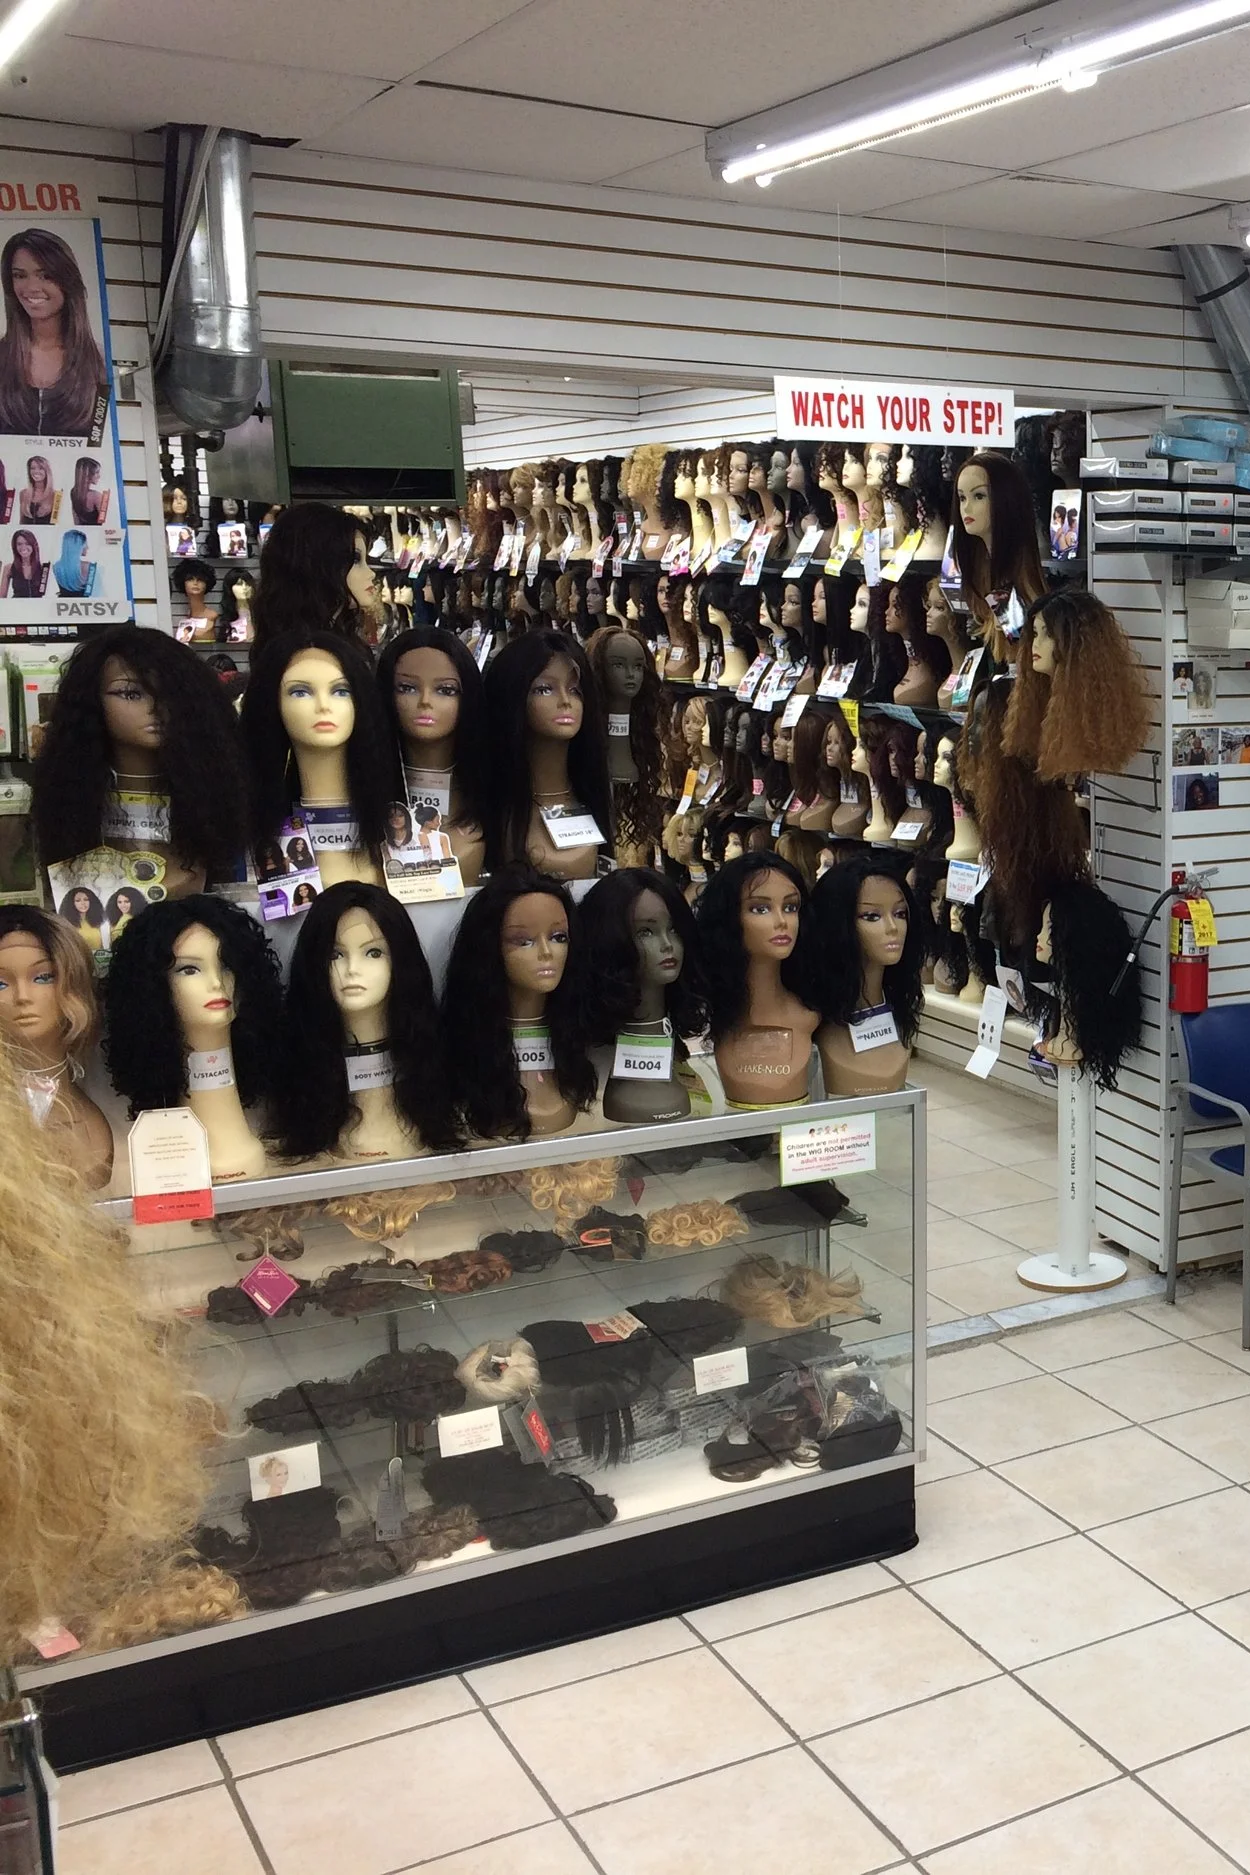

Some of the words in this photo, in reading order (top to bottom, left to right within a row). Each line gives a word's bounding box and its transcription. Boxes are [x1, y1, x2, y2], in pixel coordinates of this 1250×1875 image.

[791, 390, 864, 429] WATCH
[877, 395, 932, 432] YOUR
[943, 398, 1004, 436] STEP!
[49, 438, 83, 448] PATSY
[56, 602, 119, 616] PATSY
[355, 1072, 372, 1081] BODY
[786, 1141, 815, 1151] Children
[840, 1132, 871, 1145] permitted
[796, 1150, 807, 1158] the
[808, 1148, 822, 1156] WIG
[824, 1144, 845, 1154] ROOM
[846, 1140, 870, 1150] without
[800, 1156, 818, 1165] adult
